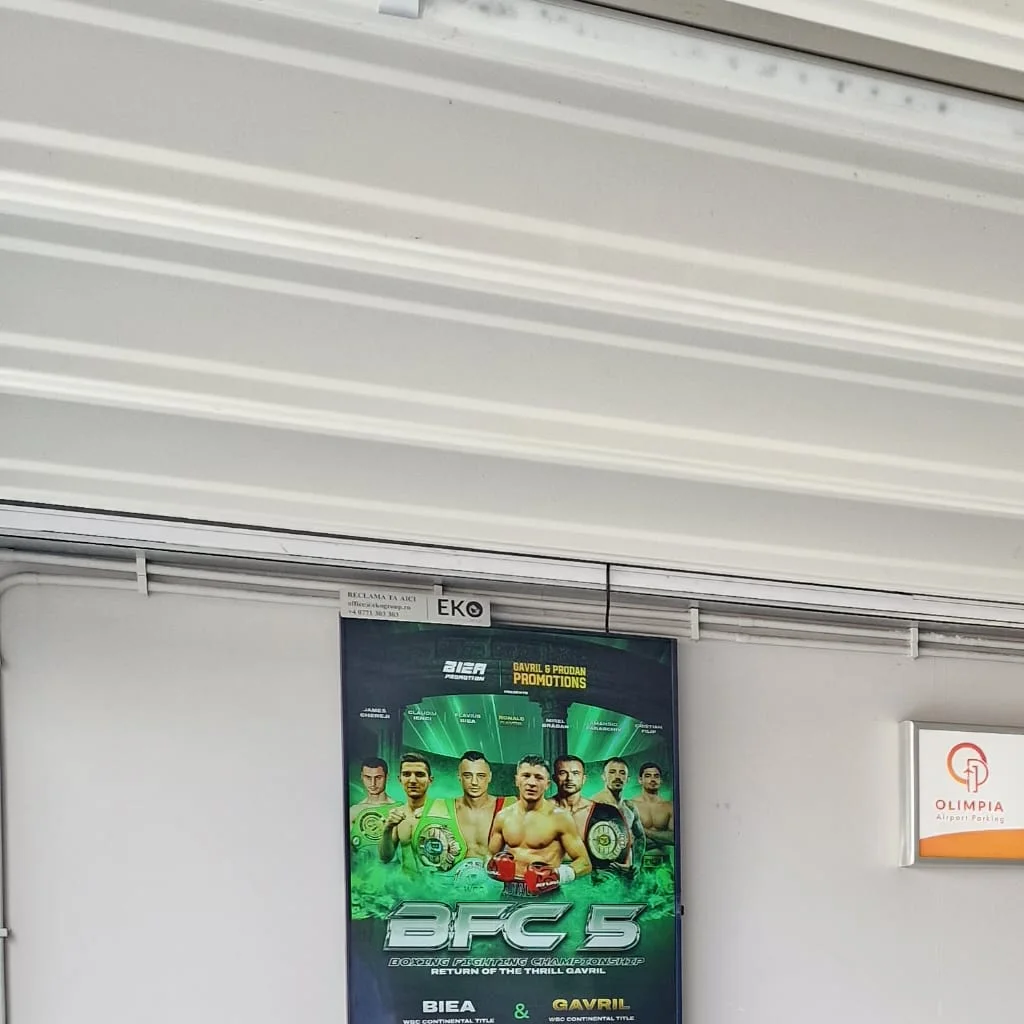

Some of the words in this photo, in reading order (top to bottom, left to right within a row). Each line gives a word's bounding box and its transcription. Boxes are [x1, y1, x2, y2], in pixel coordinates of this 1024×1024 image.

[347, 591, 386, 600] RECLAMA
[388, 593, 398, 601] TA
[437, 598, 483, 618] EKO
[442, 660, 487, 675] BIEA
[513, 661, 543, 673] GAVRIL
[544, 664, 551, 674] &
[552, 665, 586, 677] PRODAN
[513, 672, 586, 689] PROMOTIONS
[935, 799, 1004, 812] OLIMPIA
[936, 813, 968, 821] Airport
[971, 814, 1005, 825] Parking
[384, 901, 572, 951] BFC
[577, 902, 648, 951] 5
[388, 957, 450, 967] BOXING
[451, 957, 528, 967] FIGHTING
[530, 956, 645, 967] CHAMPIONSHIP
[431, 968, 480, 976] RETURN
[524, 967, 564, 975] THRILL
[565, 967, 607, 975] GAVRIL
[422, 1000, 476, 1013] BIEA
[514, 1003, 530, 1019] &
[552, 998, 631, 1011] GAVRIL
